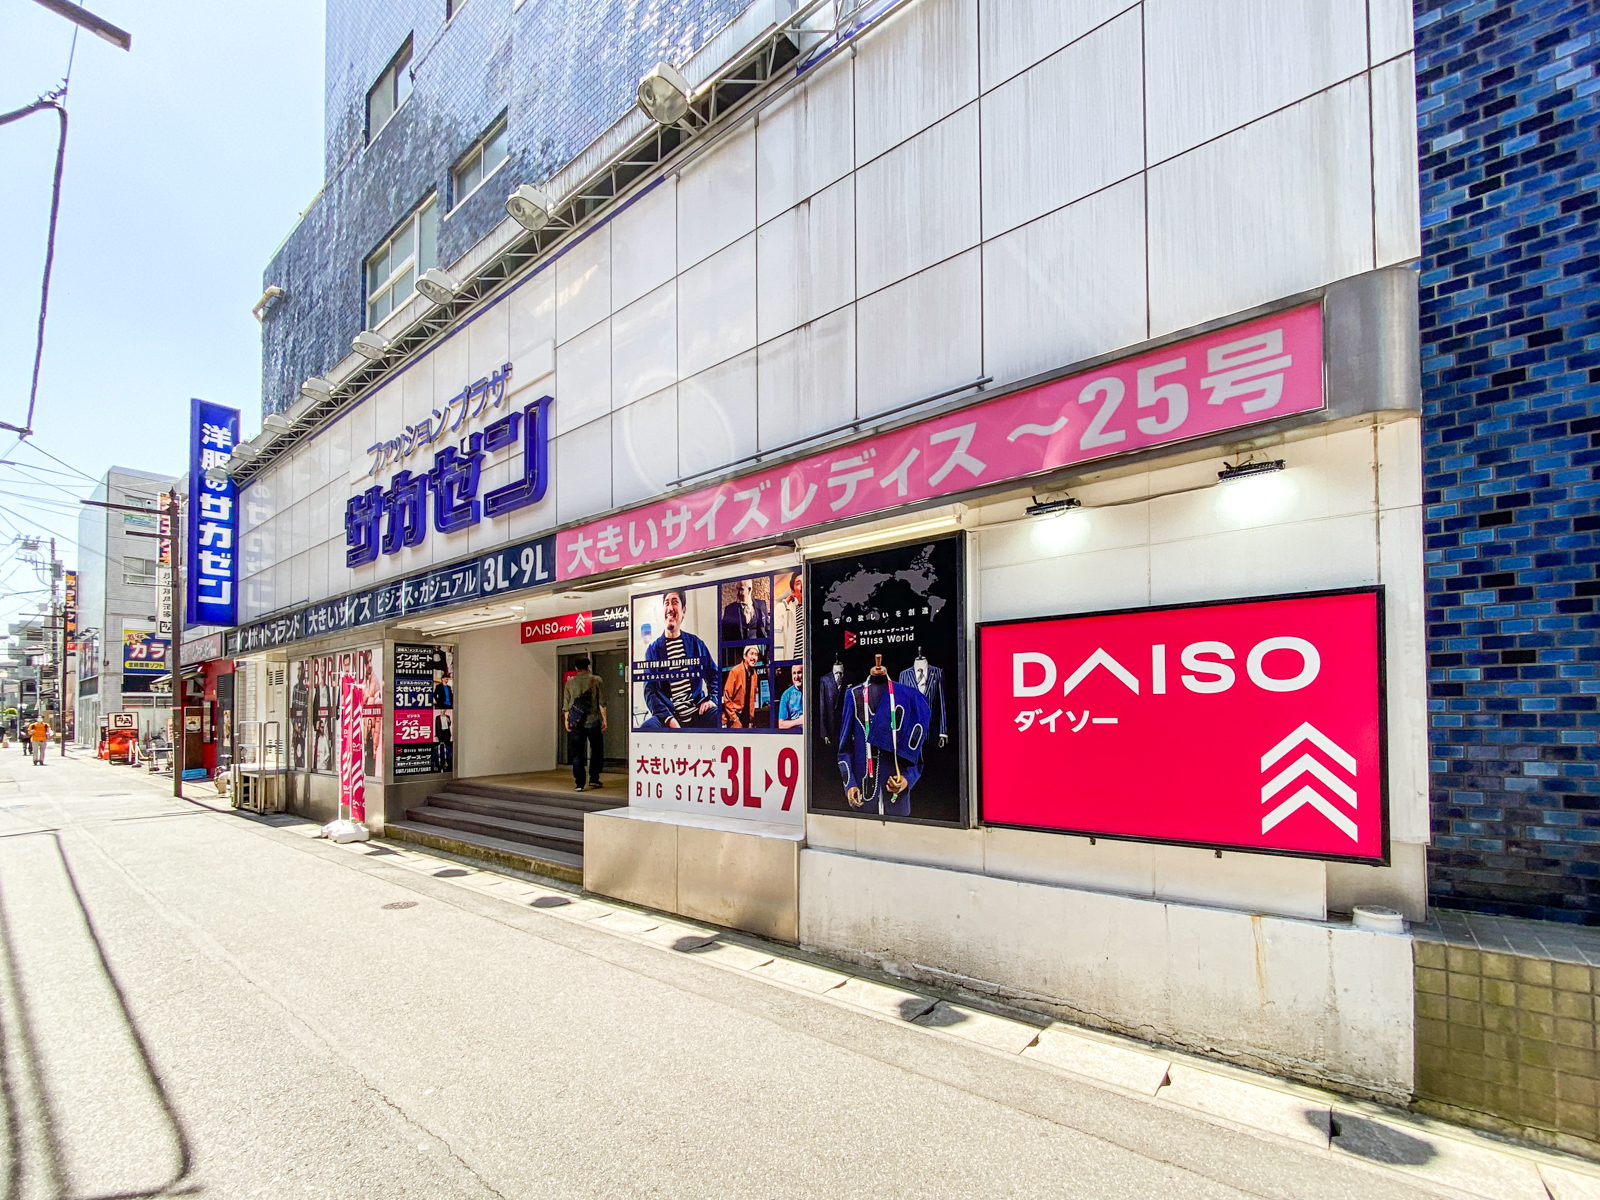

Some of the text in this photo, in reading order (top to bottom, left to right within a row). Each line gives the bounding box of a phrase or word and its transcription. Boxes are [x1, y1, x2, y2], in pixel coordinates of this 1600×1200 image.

[366, 361, 513, 477] ファッションプラザ
[344, 395, 554, 568] サカゼン
[525, 622, 559, 637] DAISO
[860, 633, 915, 646] Bliss World
[396, 653, 433, 662] インポート
[396, 661, 426, 669] ブランド
[637, 657, 701, 669] HAVE FUN AND HAPPINESS
[1013, 636, 1321, 697] DAISO
[1014, 708, 1118, 733] ダイソー
[636, 755, 716, 778] 大きいサイズ
[636, 781, 716, 804] BIG SIZE
